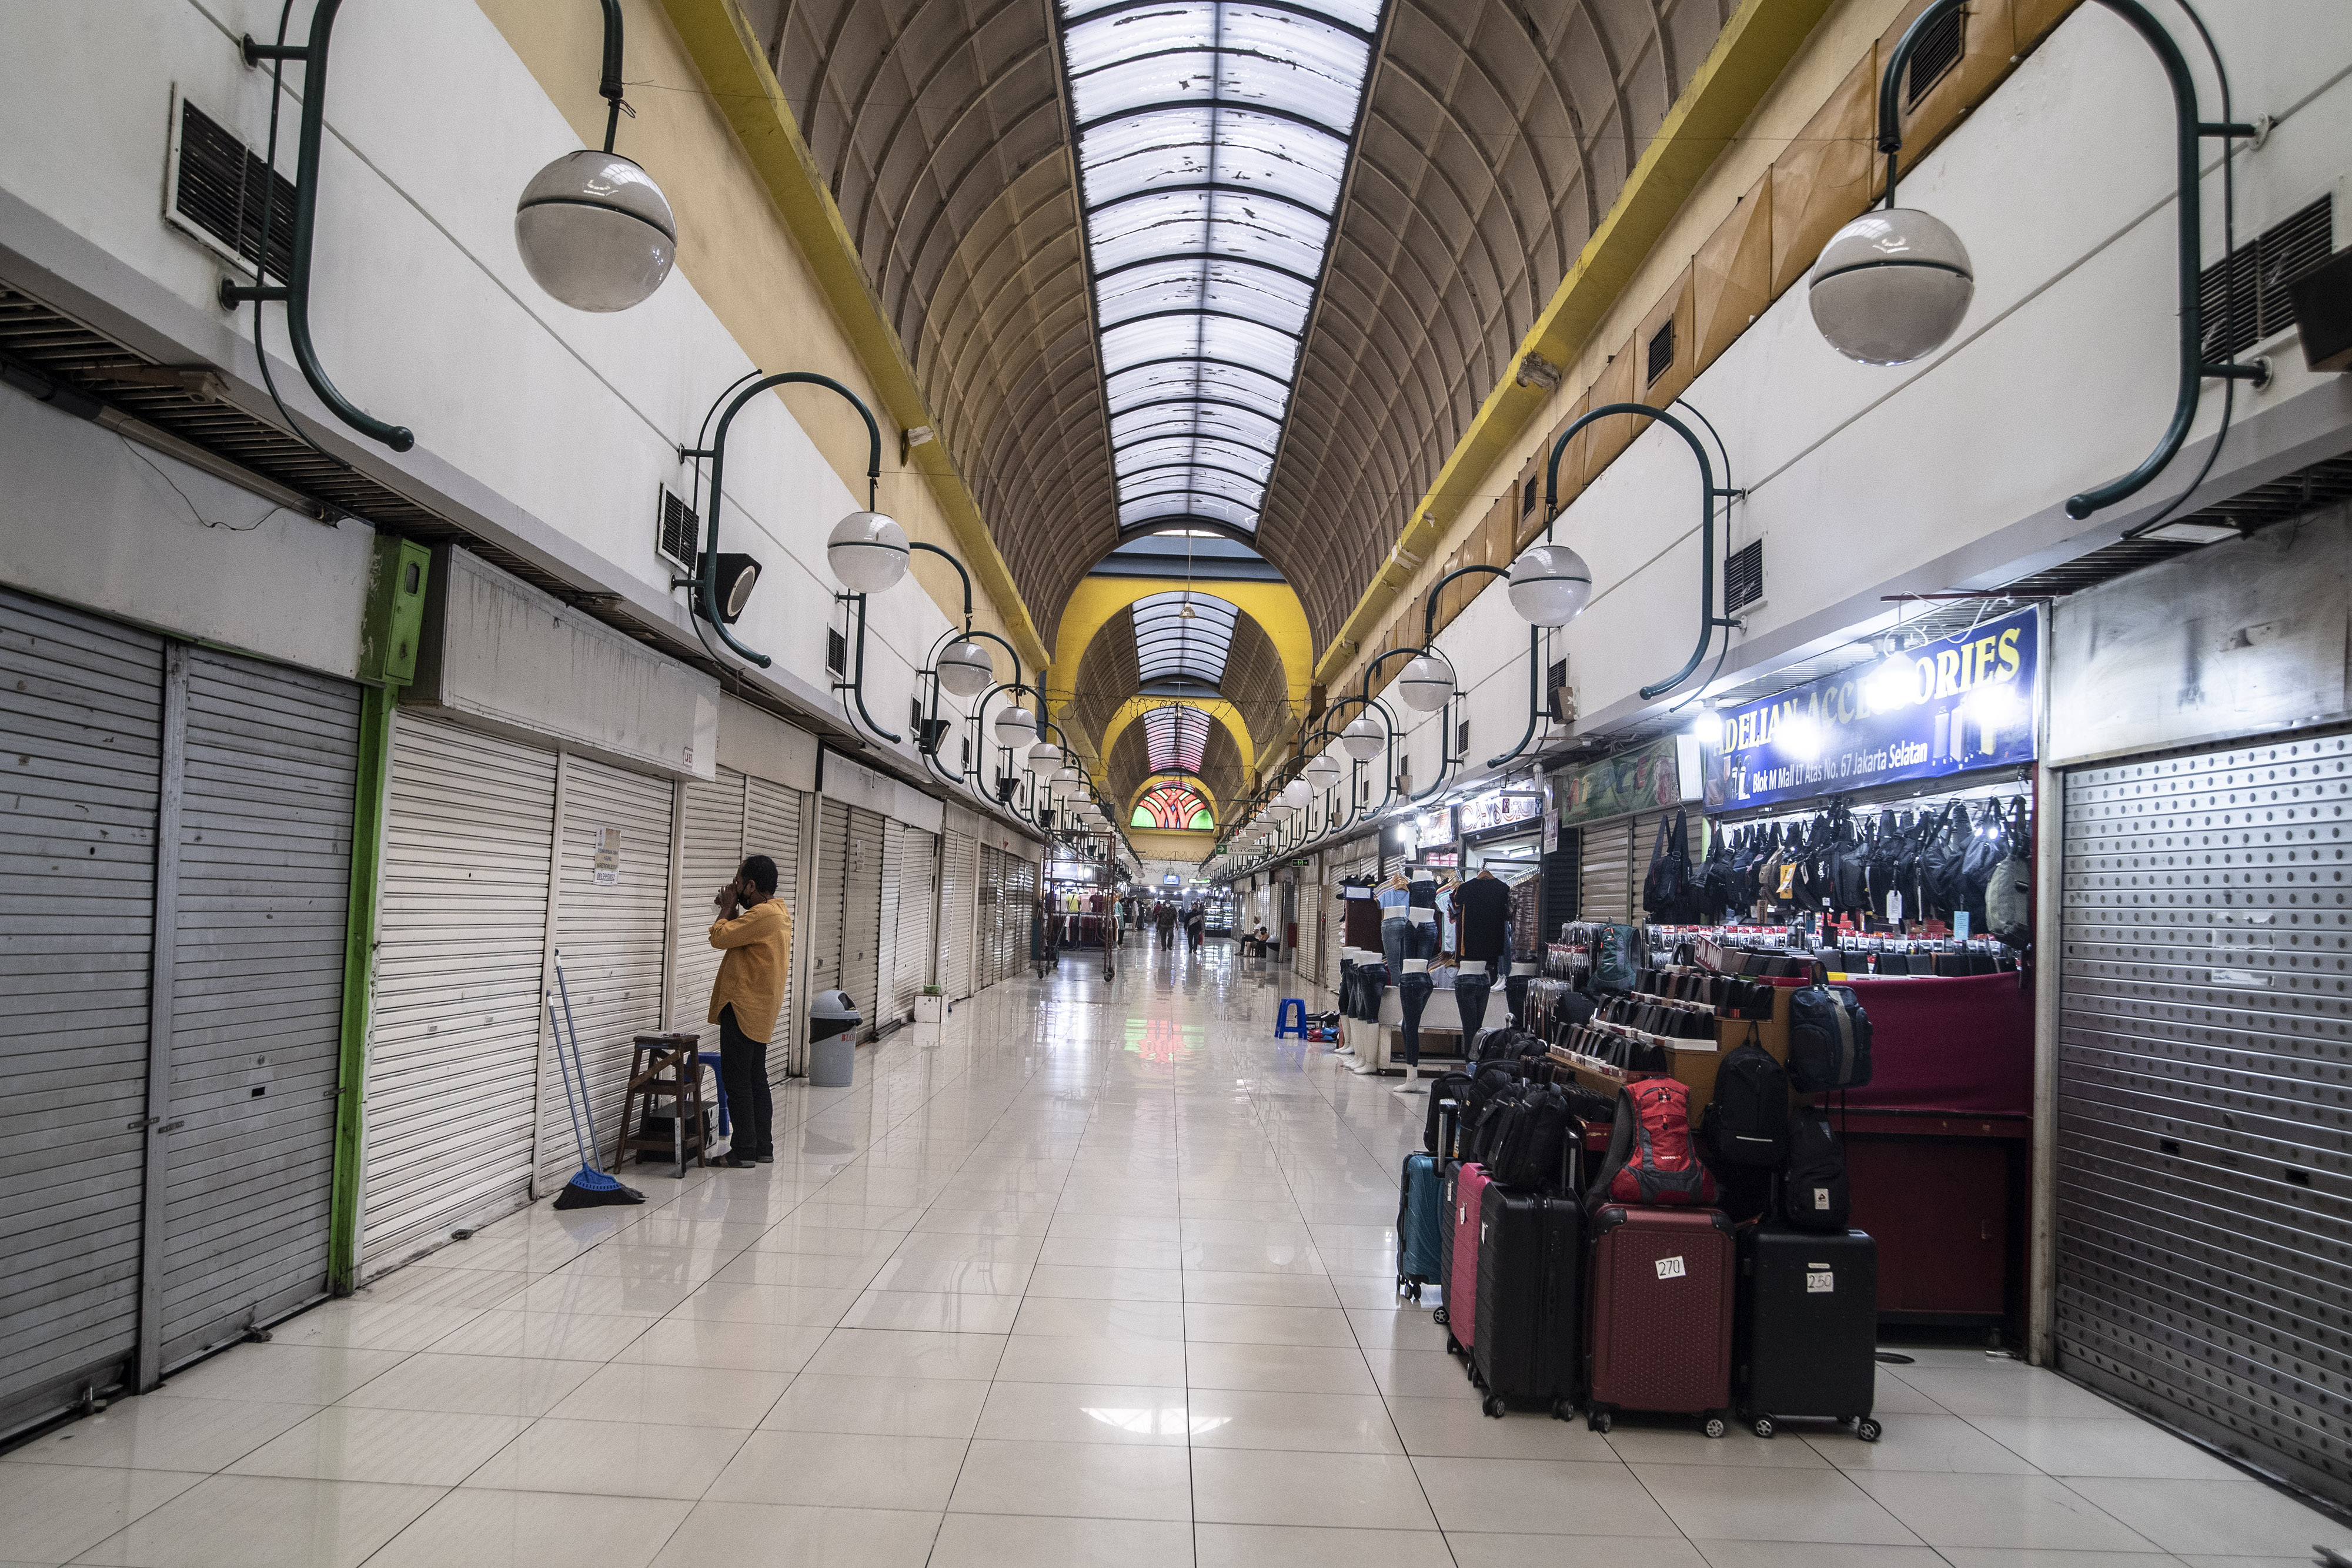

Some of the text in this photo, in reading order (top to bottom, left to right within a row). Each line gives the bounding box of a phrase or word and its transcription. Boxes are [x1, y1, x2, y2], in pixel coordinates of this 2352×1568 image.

[1805, 627, 2021, 730] ACCEORIES
[1752, 740, 1928, 793] Blok M Mall LT Atas No. 67 Jakarta Selatan
[1696, 936, 1720, 971] 50.000
[1658, 1259, 1680, 1276] 270
[1808, 1275, 1832, 1288] 250
